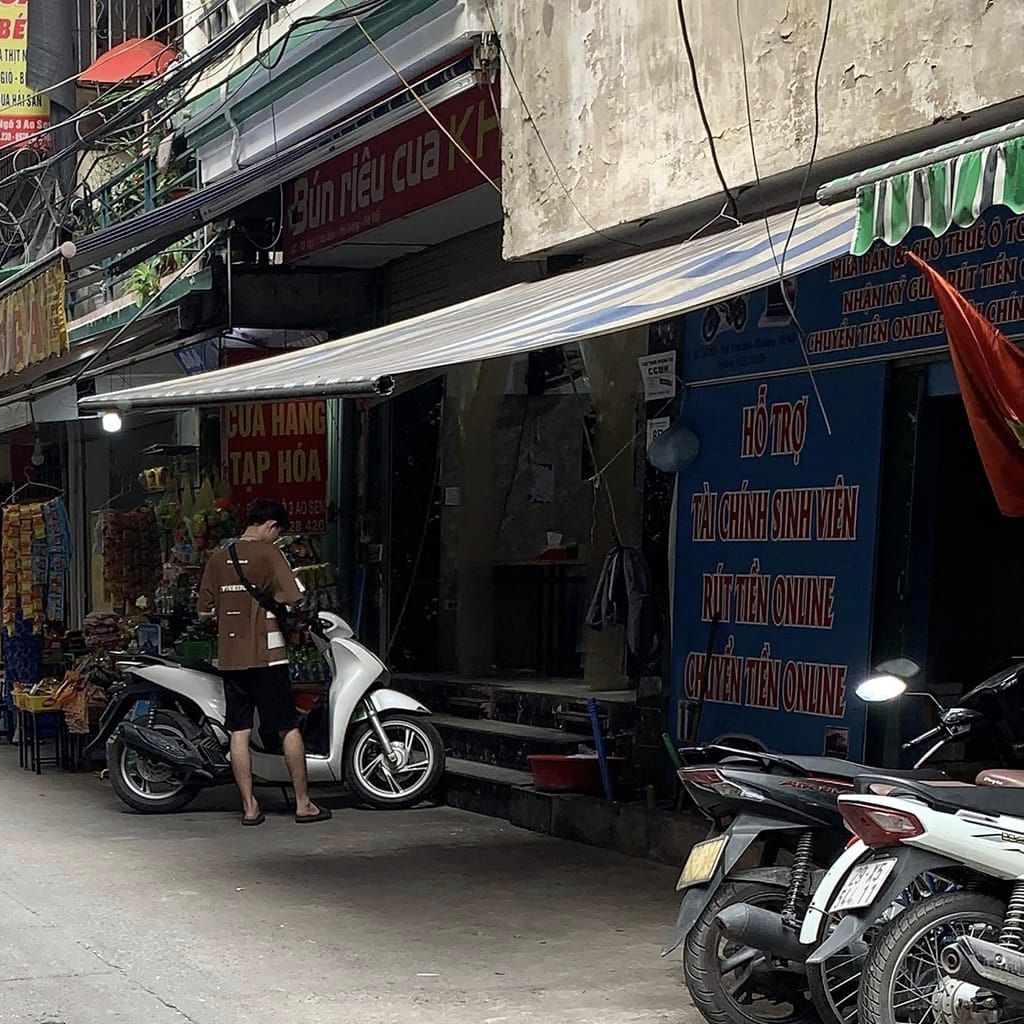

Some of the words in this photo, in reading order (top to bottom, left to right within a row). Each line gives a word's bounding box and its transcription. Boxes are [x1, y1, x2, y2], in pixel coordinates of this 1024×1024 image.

[16, 119, 22, 129] 3
[23, 119, 35, 129] Ao
[288, 171, 335, 237] Bún
[340, 147, 385, 217] riêu
[391, 129, 440, 193] cua
[842, 282, 883, 315] NHẬN
[980, 252, 1018, 289] TIỀN
[862, 244, 891, 275] BÁN
[857, 314, 890, 346] TIỀN
[891, 309, 945, 341] ONLINE
[770, 395, 809, 466] TRỢ
[229, 449, 271, 493] TẠP
[277, 441, 322, 484] HÓA
[690, 482, 718, 541] TÀI
[718, 480, 770, 542] CHÍNH
[771, 488, 813, 542] SINH
[814, 474, 861, 541] VIÊN
[701, 563, 734, 623] RÚT
[735, 558, 771, 625] TIỀN
[771, 574, 837, 629] ONLINE
[744, 642, 782, 711] TIỀN
[782, 660, 848, 718] ONLINE
